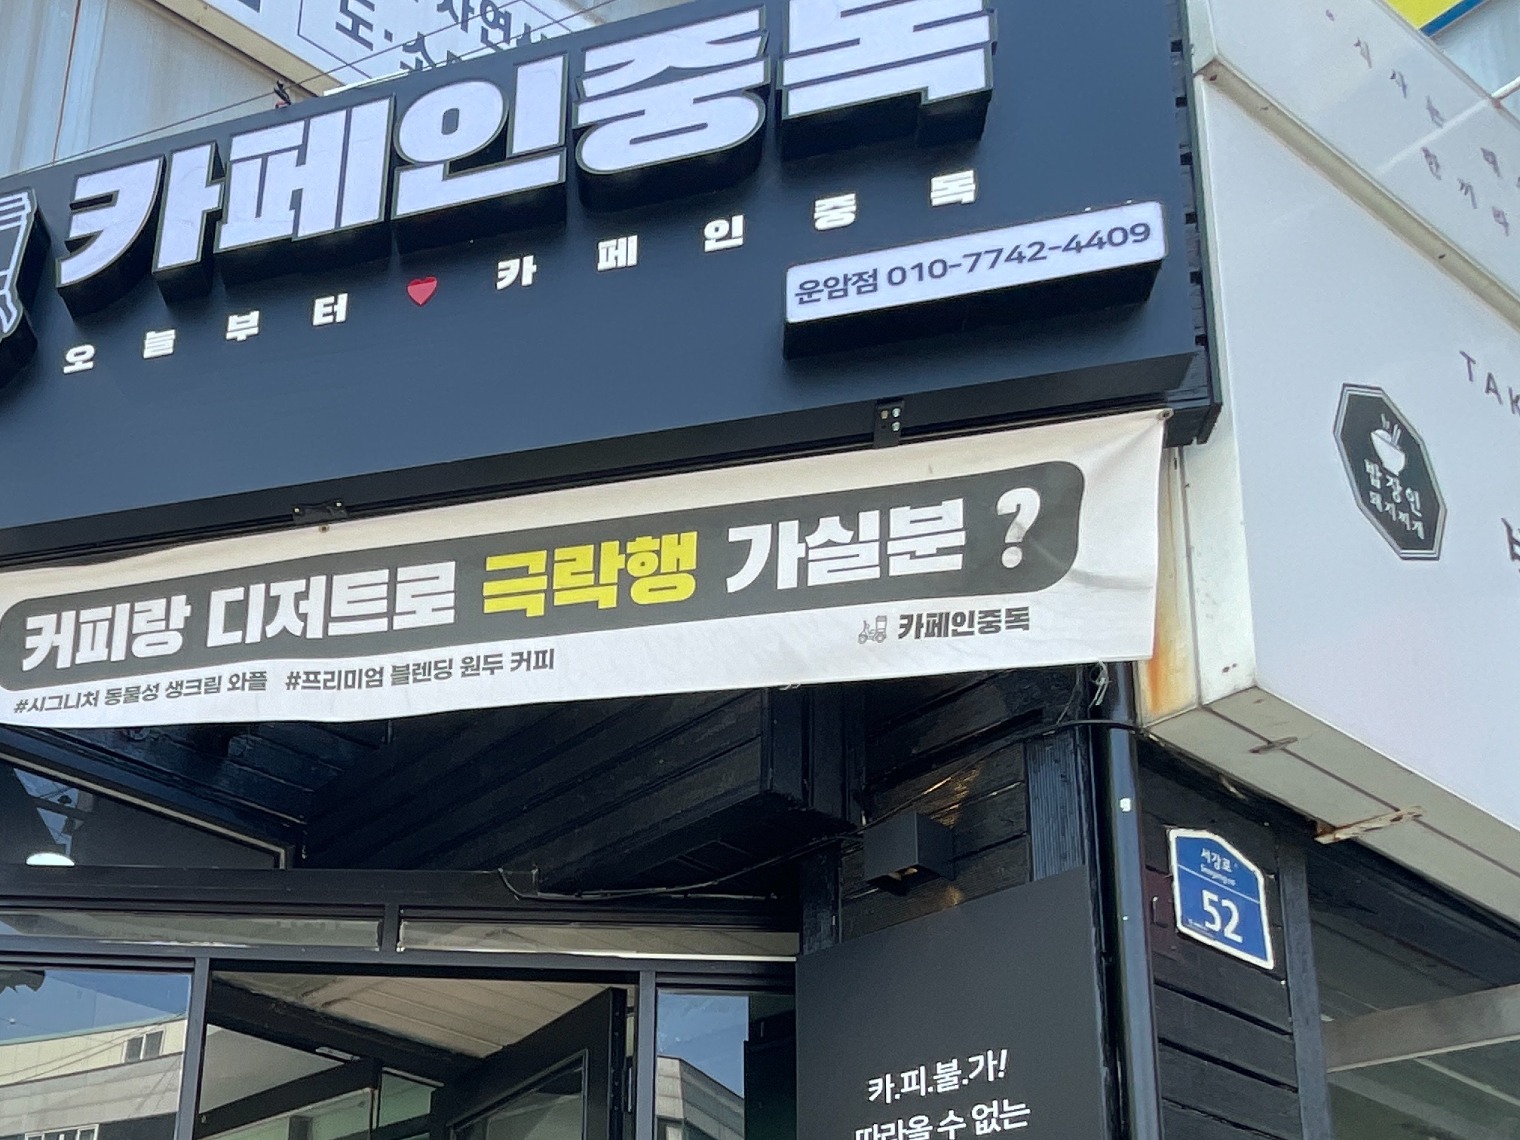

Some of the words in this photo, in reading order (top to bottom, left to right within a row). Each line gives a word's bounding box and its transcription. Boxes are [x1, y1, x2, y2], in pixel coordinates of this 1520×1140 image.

[56, 0, 994, 289] 카페인중독
[63, 294, 349, 374] 오늘부터
[496, 169, 977, 289] 카페인중독
[794, 269, 879, 306] 운암점
[886, 222, 1151, 288] 010-7742-4409
[21, 597, 192, 672] 커피랑
[206, 560, 456, 648] 디저트로
[482, 531, 699, 617] 극락행
[726, 498, 967, 595] 가실분
[996, 486, 1041, 570] ?
[897, 606, 1031, 641] 카페인중독
[13, 685, 99, 715] #시그니처
[104, 679, 161, 708] 동물성
[165, 673, 223, 700] 생크림
[227, 669, 269, 694] 와플
[285, 663, 385, 693] #프리미엄
[390, 654, 454, 685] 블렌딩
[459, 649, 505, 678] 원두
[510, 647, 556, 674] 커피
[1202, 889, 1244, 944] 52
[936, 1109, 967, 1140] 수
[971, 1098, 1031, 1136] 없는
